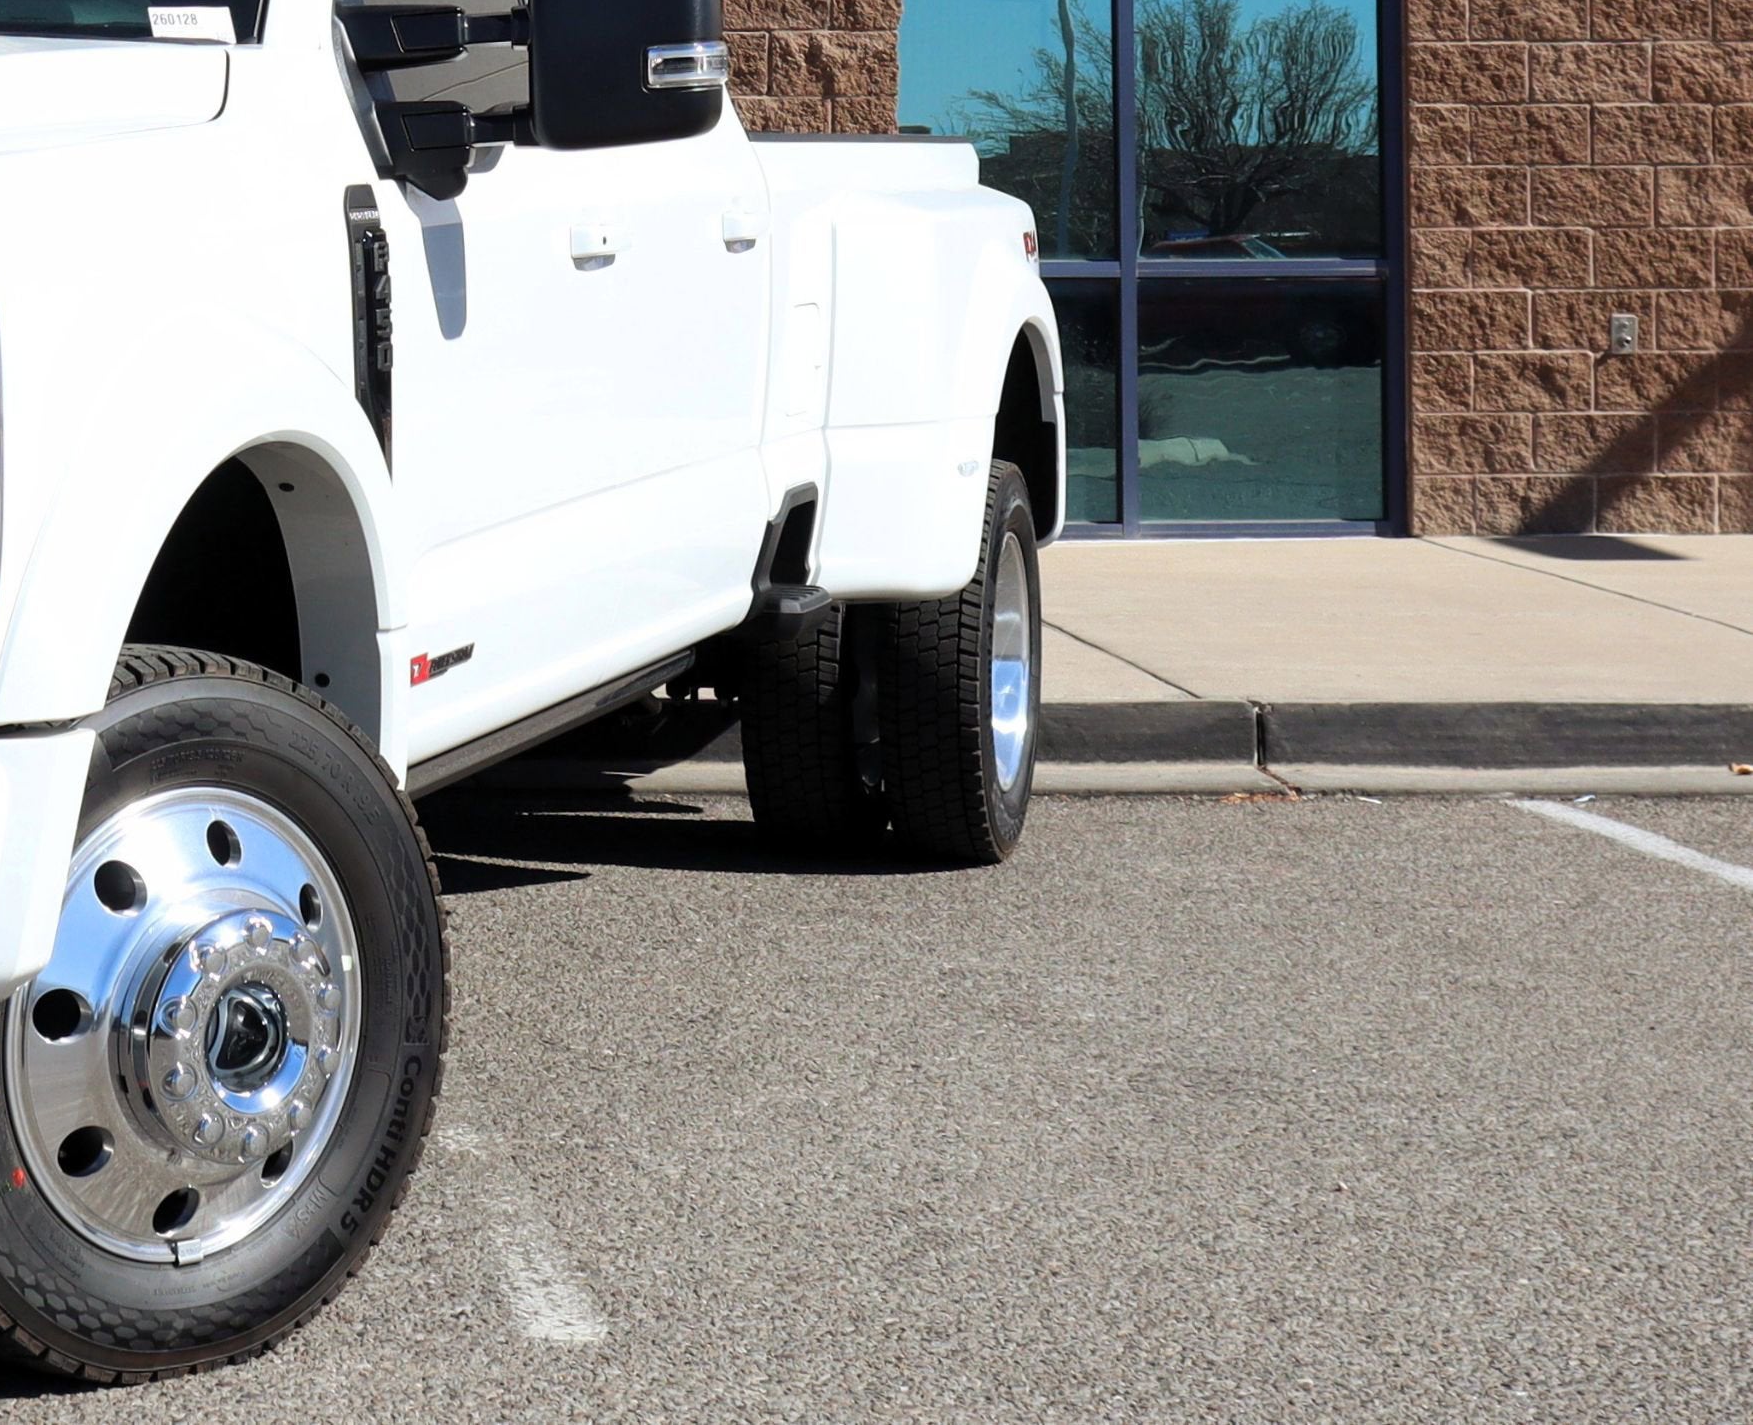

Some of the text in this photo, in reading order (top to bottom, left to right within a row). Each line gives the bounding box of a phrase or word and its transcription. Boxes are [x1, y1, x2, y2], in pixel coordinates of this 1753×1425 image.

[151, 13, 199, 26] 260128
[340, 1055, 422, 1238] Conti HDR 5
